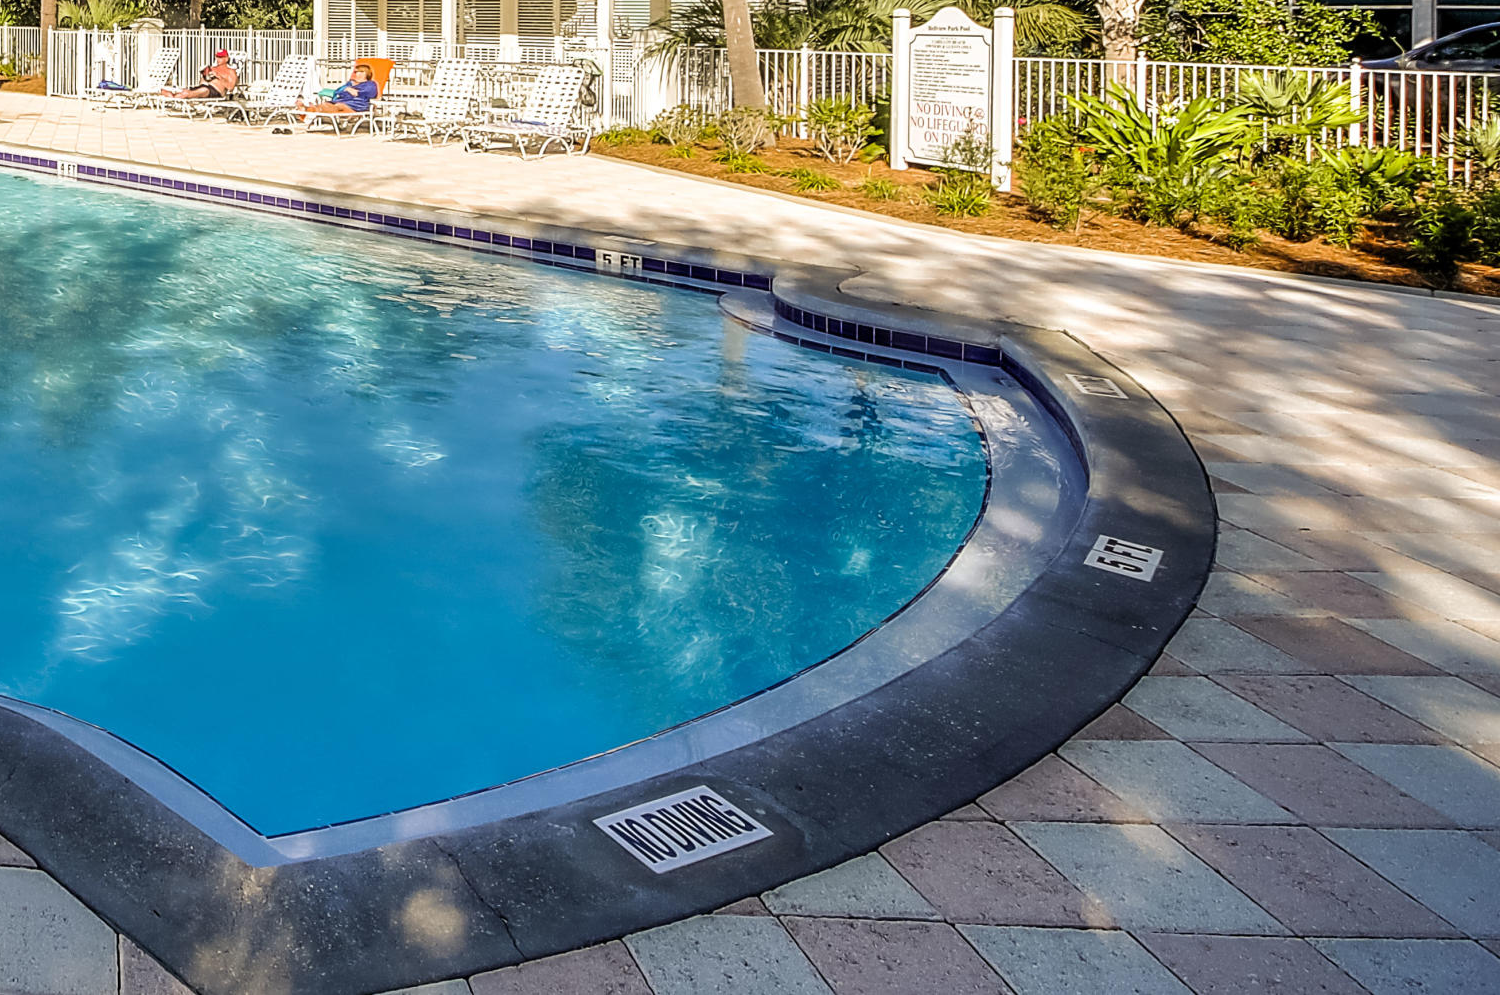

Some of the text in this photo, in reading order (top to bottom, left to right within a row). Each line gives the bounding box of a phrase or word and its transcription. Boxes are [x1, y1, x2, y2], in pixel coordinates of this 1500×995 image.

[916, 102, 972, 119] NO DIVING
[910, 116, 925, 128] NO
[924, 130, 939, 143] ON
[67, 163, 76, 175] FT
[602, 253, 640, 270] 5 FT
[1096, 556, 1143, 573] 5
[607, 794, 758, 864] NO DIVING
